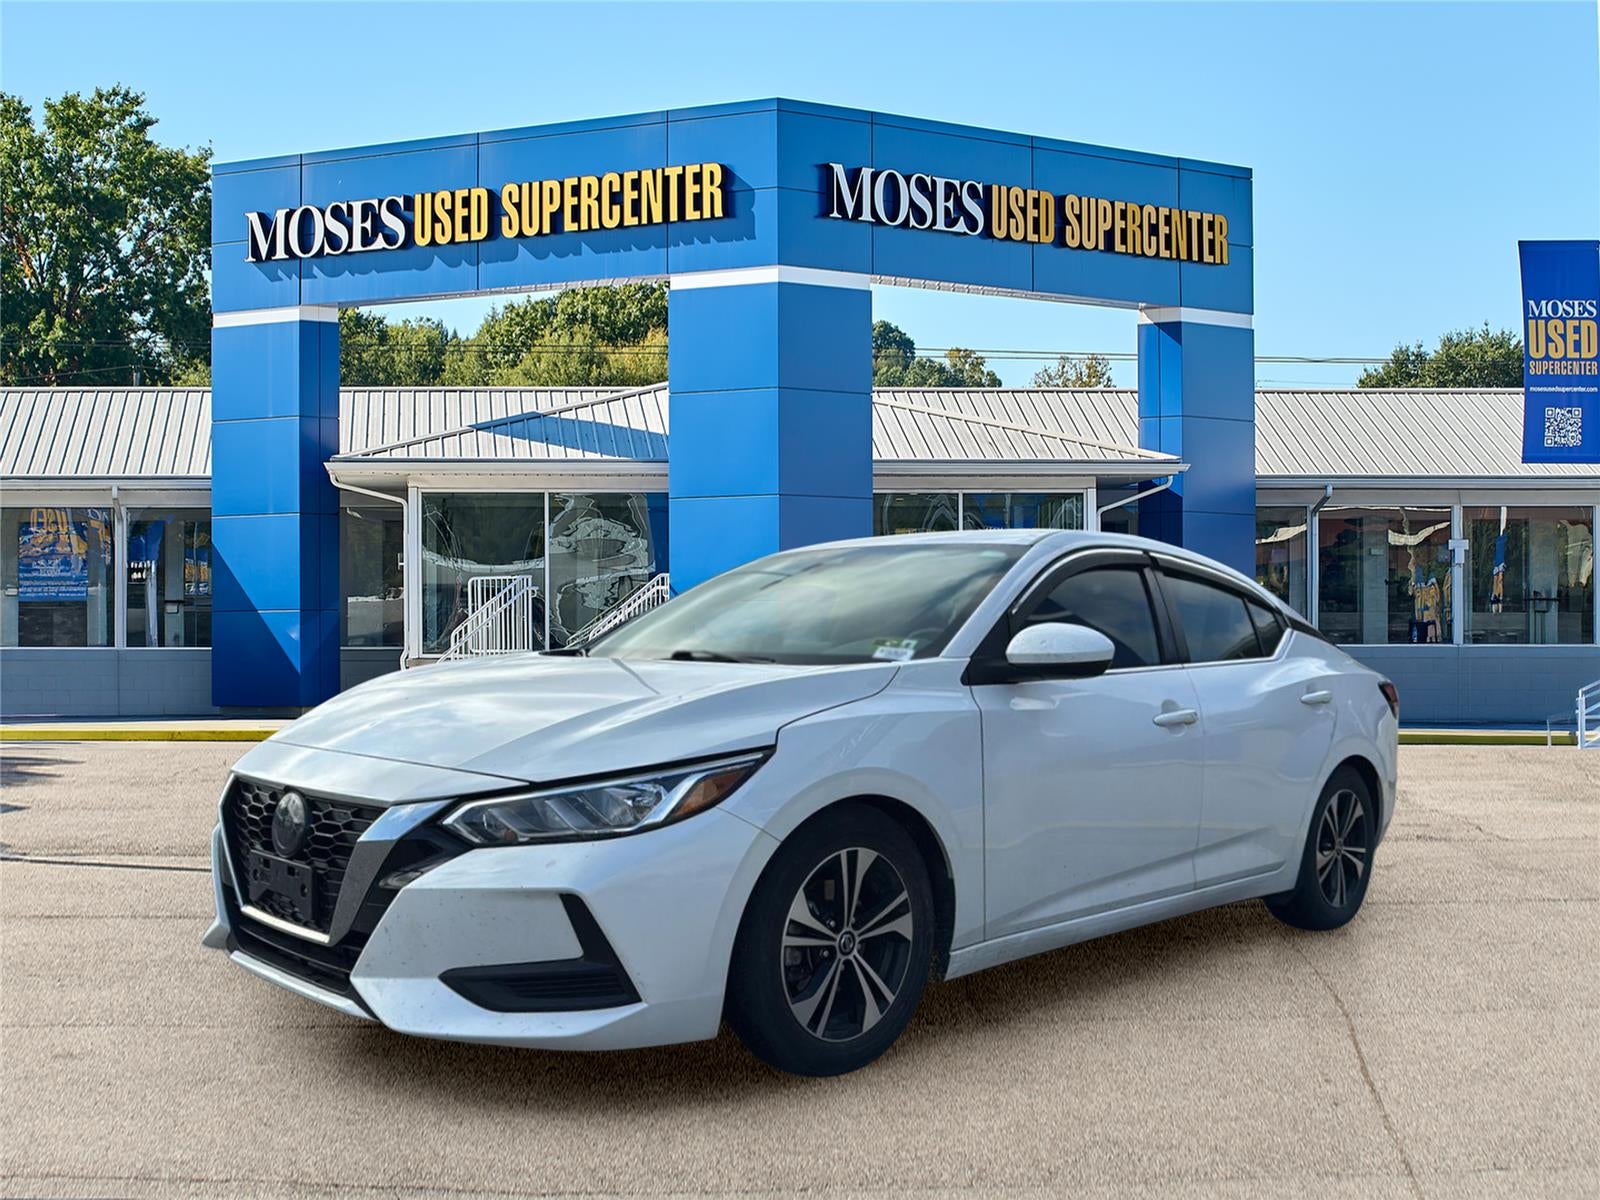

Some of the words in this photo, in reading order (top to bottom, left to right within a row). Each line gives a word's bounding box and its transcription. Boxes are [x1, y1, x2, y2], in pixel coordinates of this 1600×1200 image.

[244, 194, 407, 263] MOSES
[413, 187, 489, 248] USED
[501, 162, 725, 239] SUPERCENTER
[828, 162, 985, 236] MOSES
[991, 183, 1055, 244] USED
[1065, 193, 1230, 265] SUPERCENTER
[1527, 300, 1597, 318] MOSES
[1528, 319, 1598, 359] USED
[1529, 360, 1598, 376] SUPERCENTER
